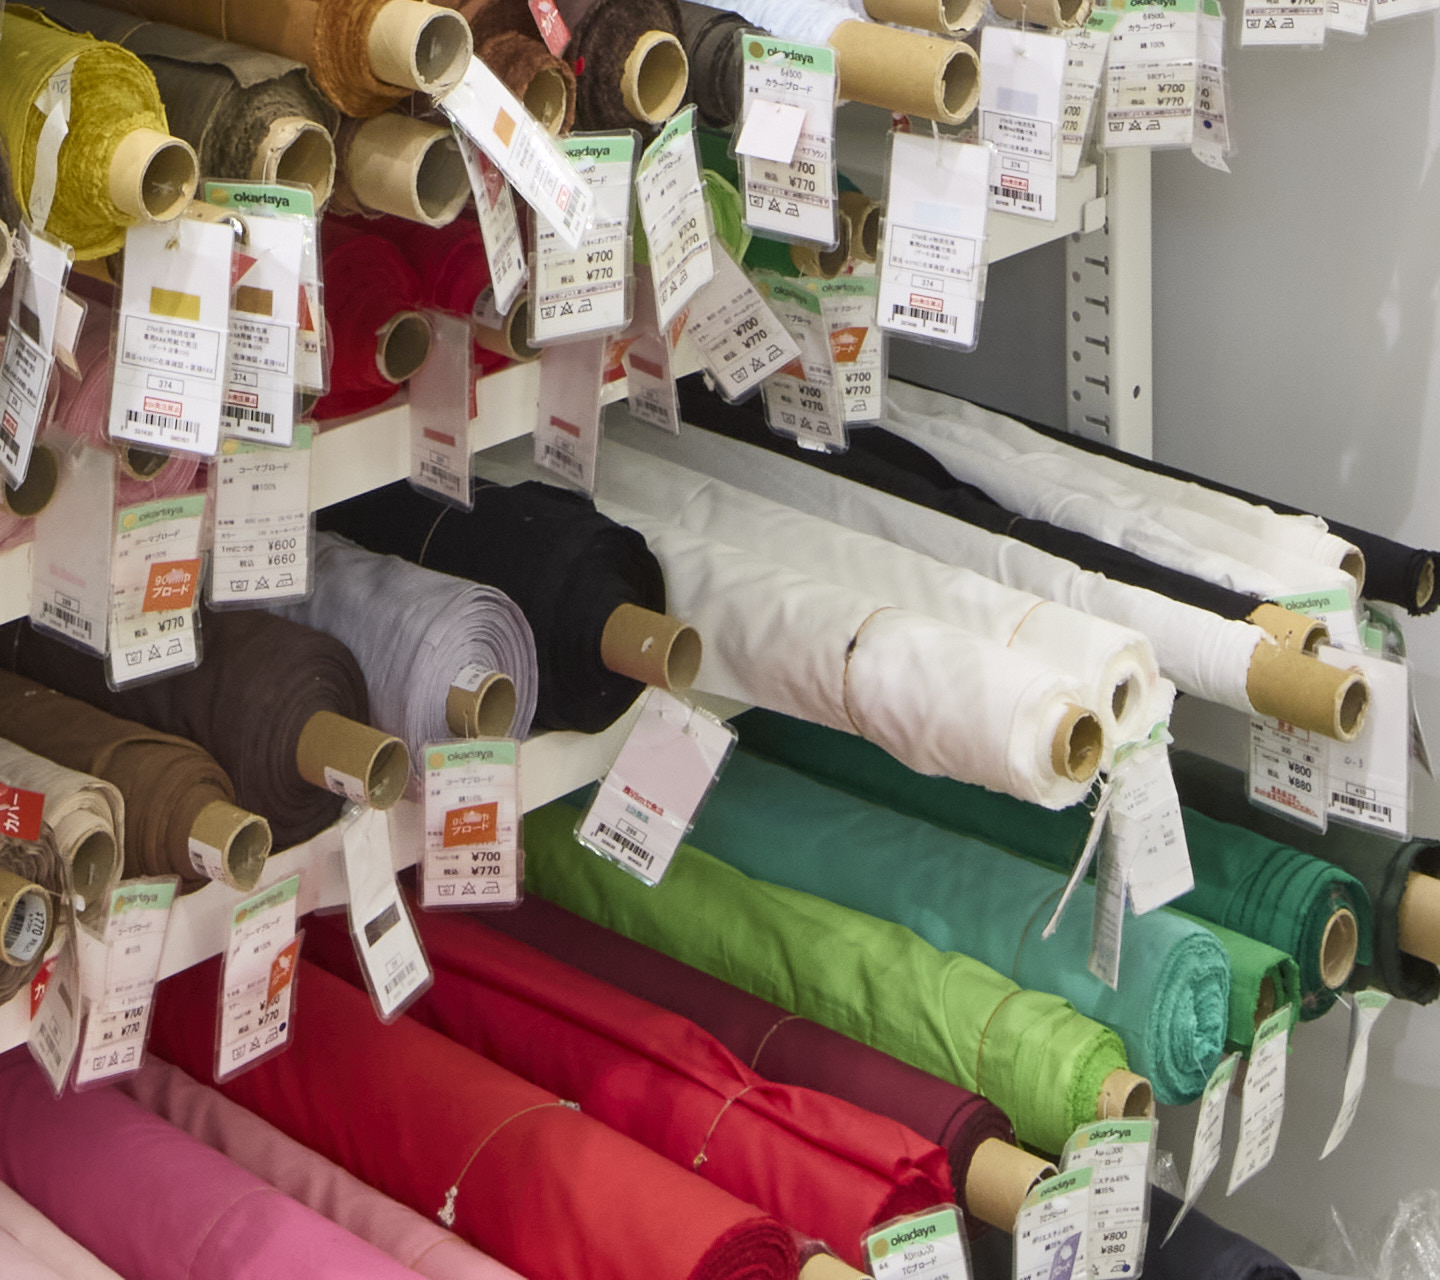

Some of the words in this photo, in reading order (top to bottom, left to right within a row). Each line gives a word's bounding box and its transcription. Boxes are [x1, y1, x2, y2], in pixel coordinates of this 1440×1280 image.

[767, 45, 814, 66] okadaya
[1158, 83, 1185, 93] ¥700
[1157, 96, 1184, 107] ¥770
[789, 176, 816, 192] ¥770
[586, 249, 614, 263] ¥700
[586, 266, 613, 280] ¥770
[472, 851, 501, 862] ¥700
[471, 865, 501, 876] ¥770
[890, 1223, 936, 1247] okadaya
